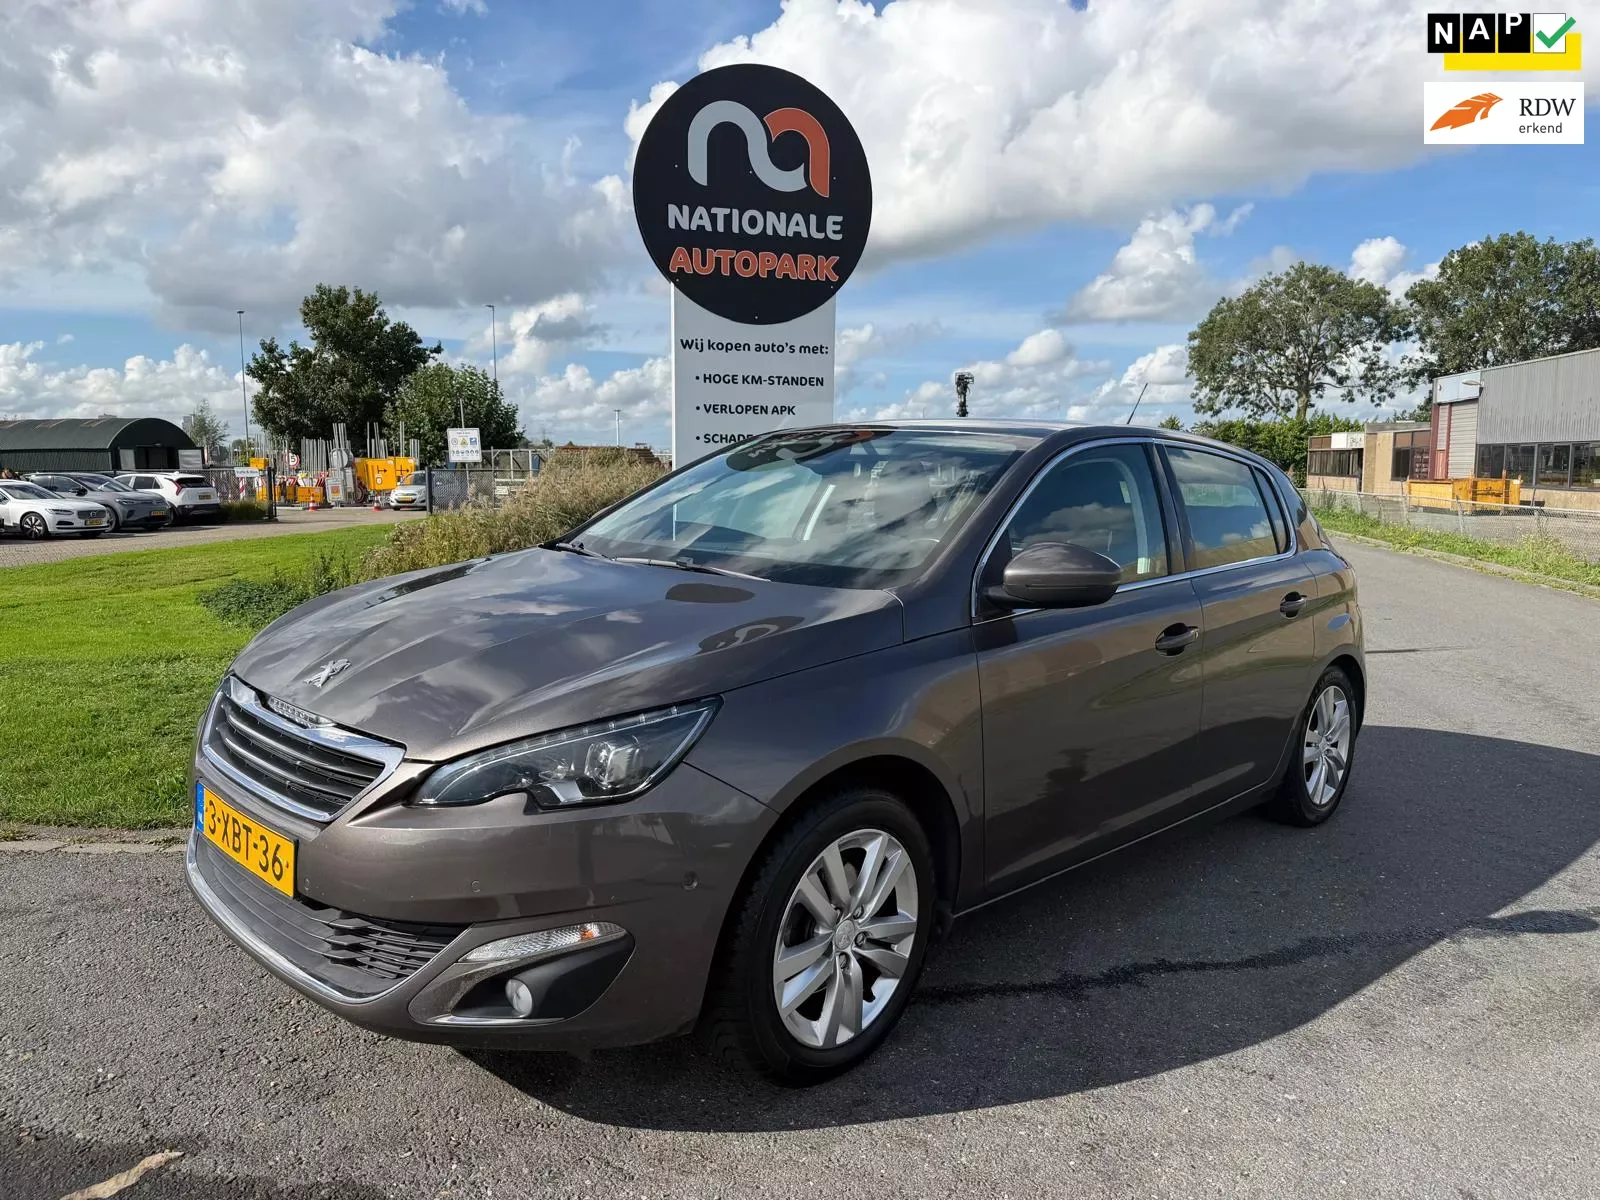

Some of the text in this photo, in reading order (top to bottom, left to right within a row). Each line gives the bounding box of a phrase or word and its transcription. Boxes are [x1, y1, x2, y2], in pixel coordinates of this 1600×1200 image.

[667, 203, 843, 240] NATIONALE
[669, 246, 840, 282] AUTOPARK
[680, 338, 829, 355] Wij kopen auto's met:
[703, 373, 824, 387] HOGE KM-STANDEN
[703, 403, 796, 416] VERLOPEN APK
[208, 799, 284, 881] 3-XBT-36
